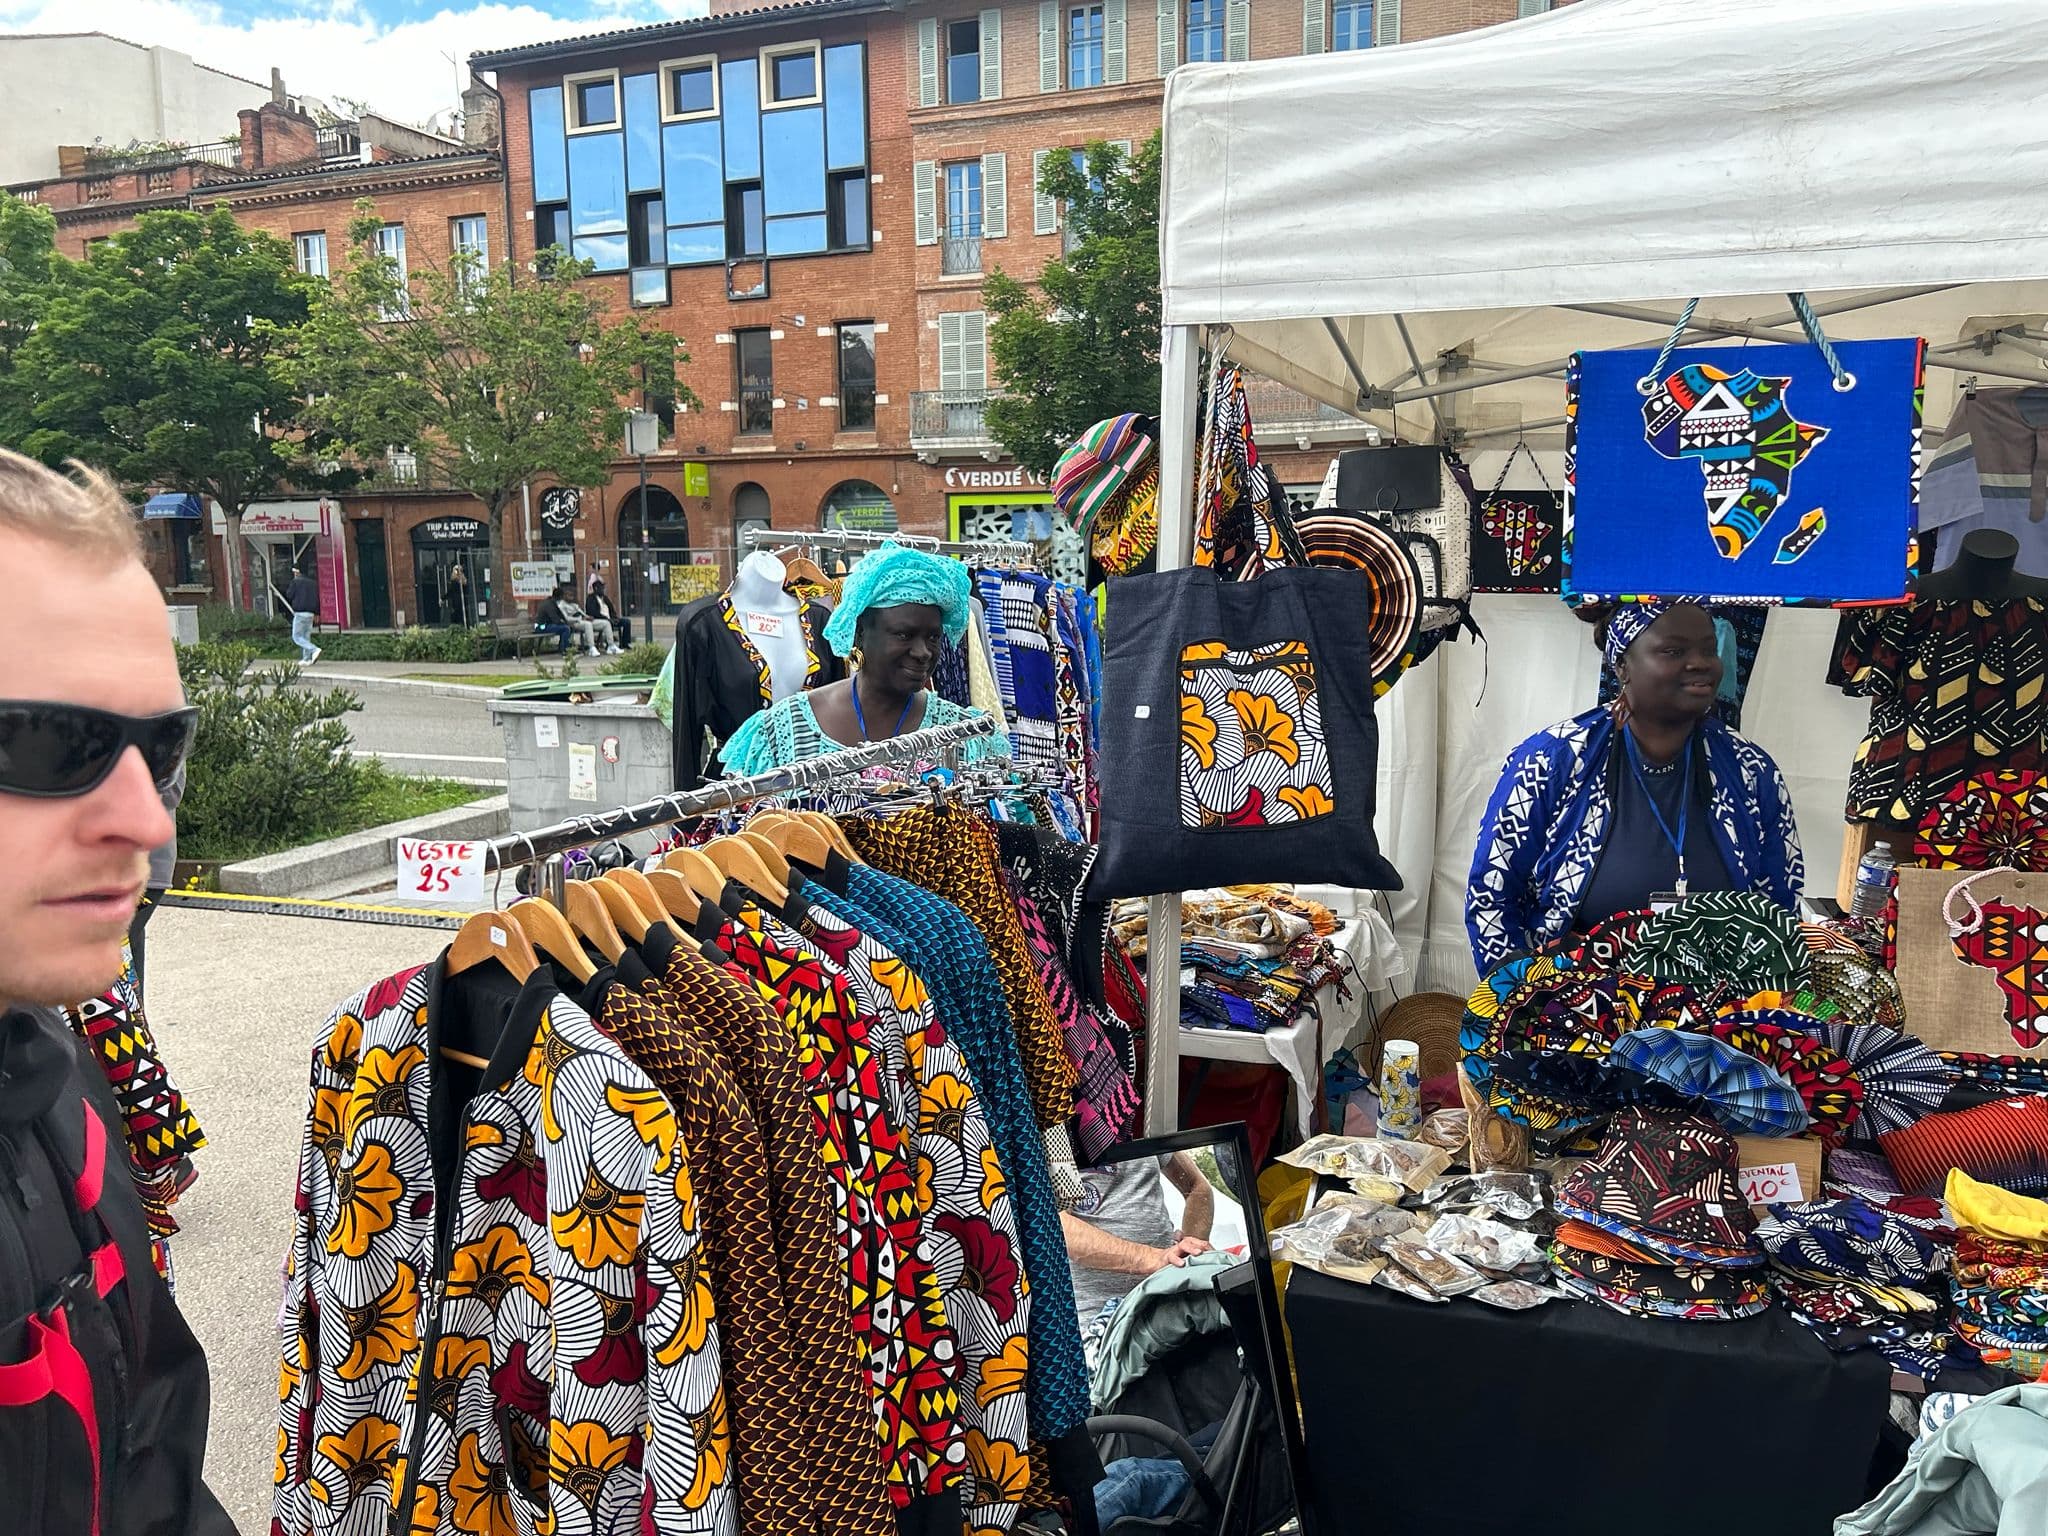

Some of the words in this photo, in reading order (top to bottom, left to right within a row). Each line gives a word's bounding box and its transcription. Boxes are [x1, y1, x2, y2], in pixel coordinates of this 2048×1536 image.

[959, 466, 1025, 487] VERDIÉ
[851, 502, 885, 517] VERDIÉ
[426, 523, 441, 531] TRIP
[402, 842, 474, 861] VESTE
